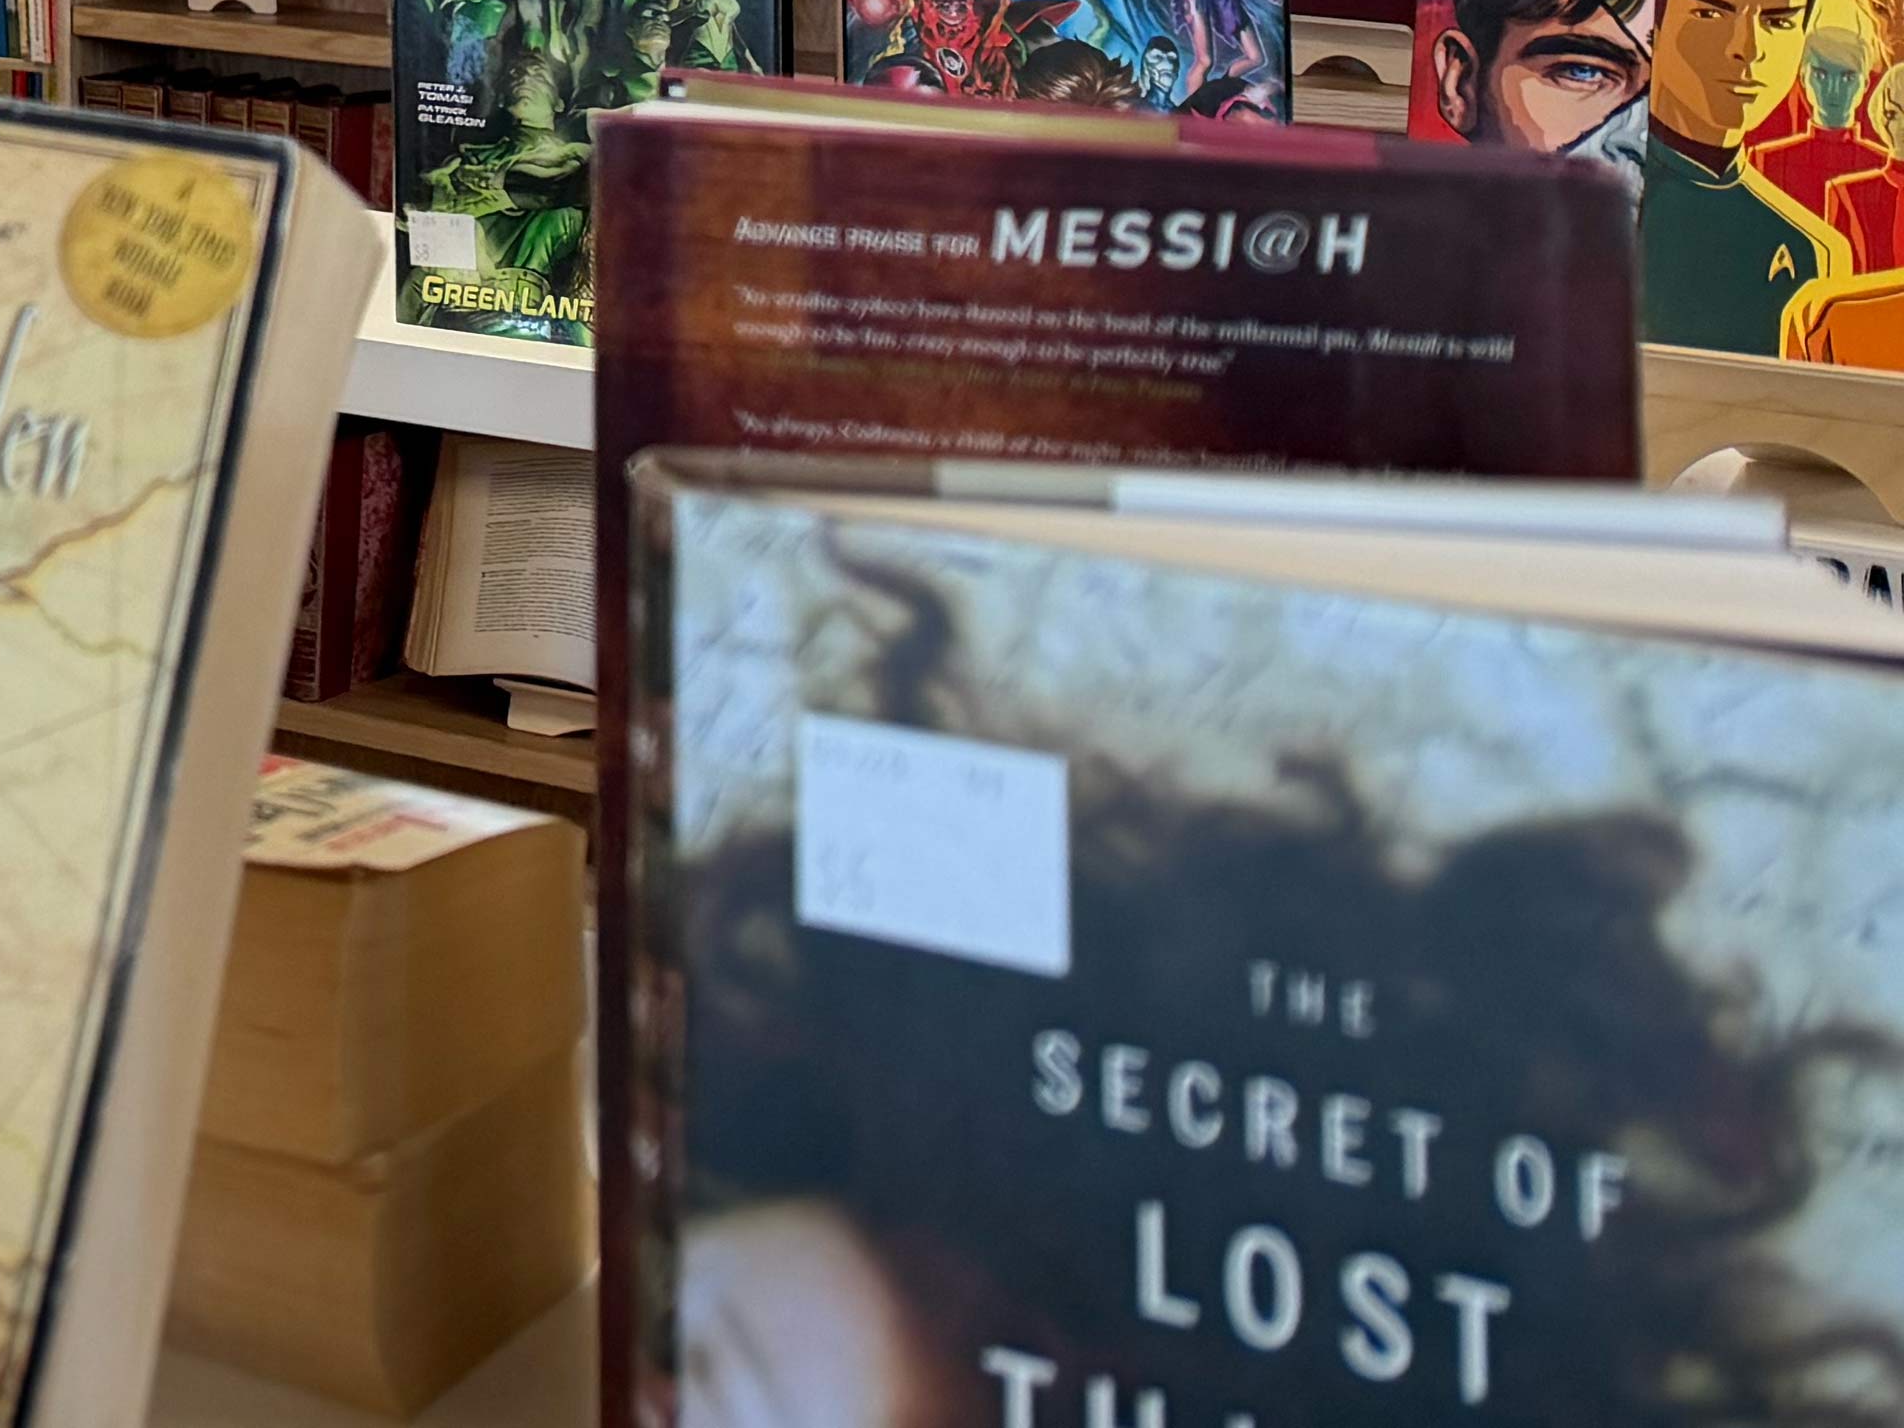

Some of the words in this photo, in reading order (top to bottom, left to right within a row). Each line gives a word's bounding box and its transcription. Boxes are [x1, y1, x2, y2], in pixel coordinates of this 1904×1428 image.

[418, 90, 474, 104] TOMASI
[418, 113, 486, 129] GLEASON
[991, 206, 1370, 275] MESSI@H
[421, 274, 515, 313] GREEN
[1248, 957, 1377, 1040] THE
[1029, 1028, 1445, 1202] SECRET
[1494, 1132, 1633, 1245] OF
[1133, 1198, 1514, 1408] LOST
